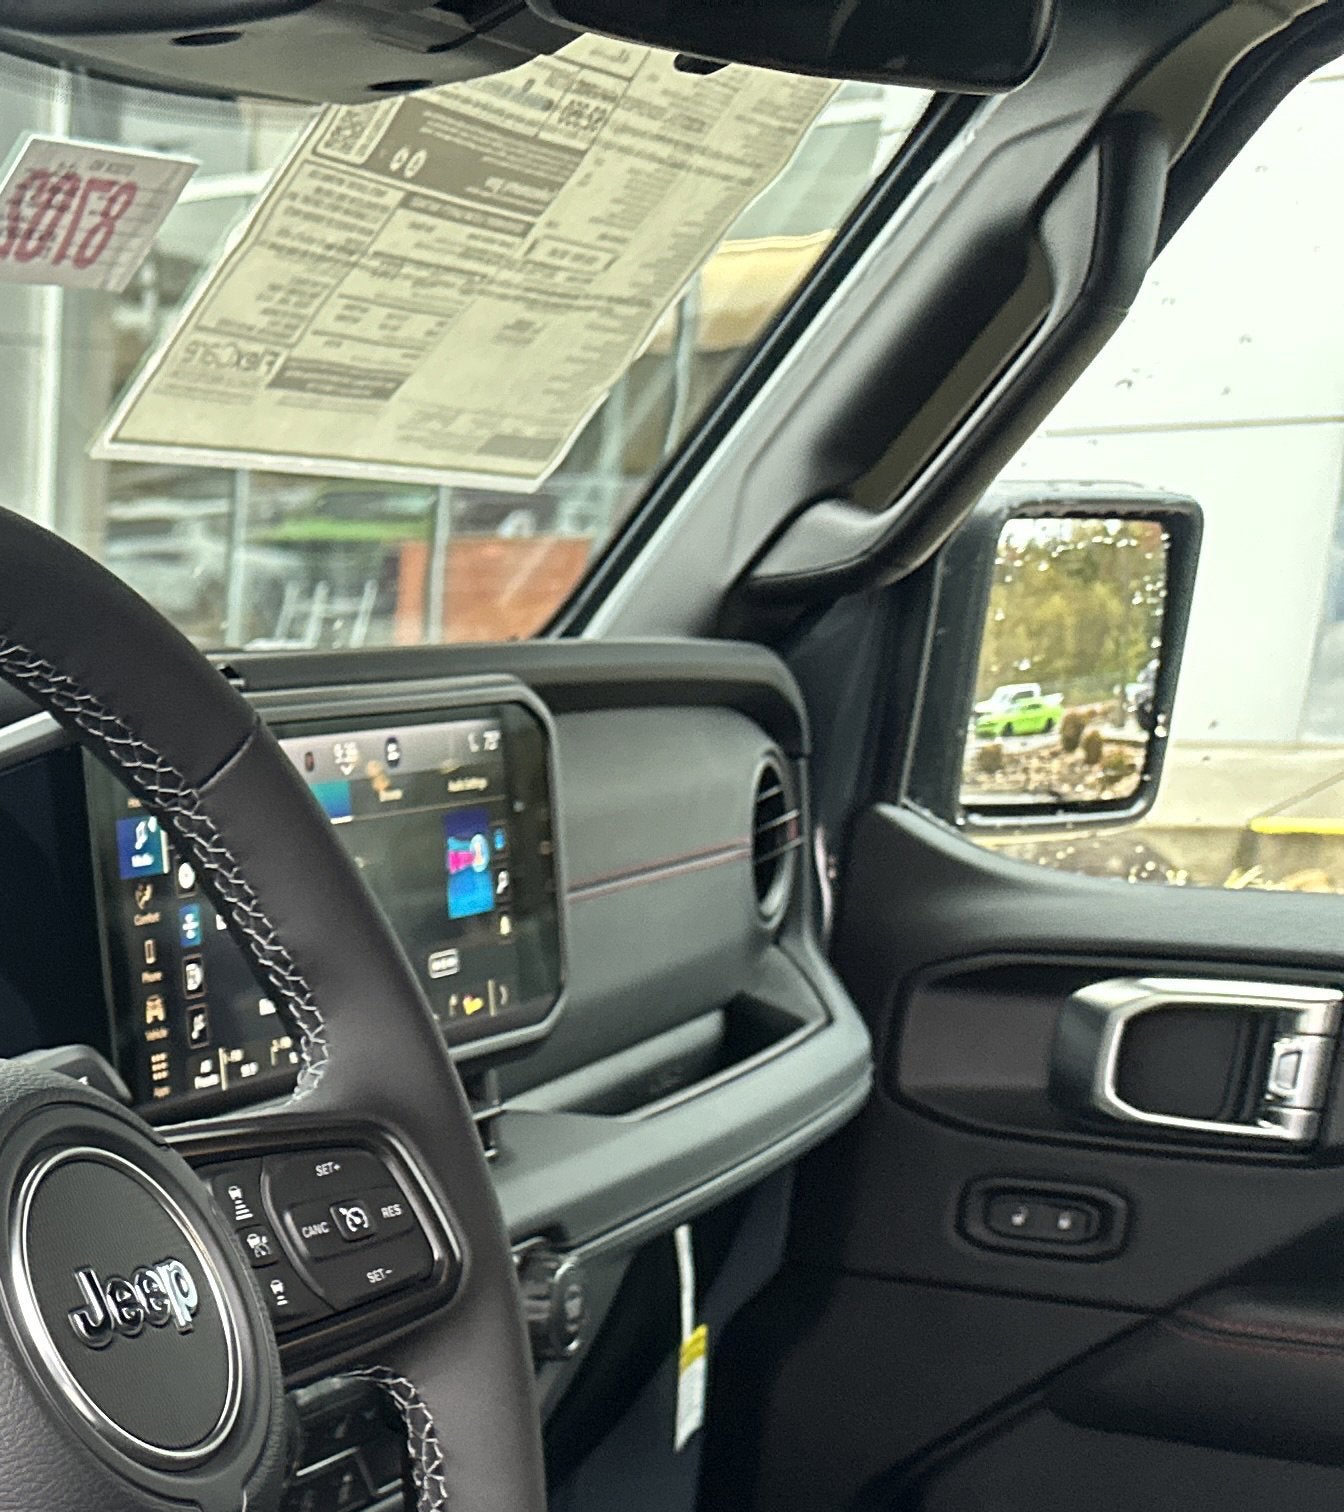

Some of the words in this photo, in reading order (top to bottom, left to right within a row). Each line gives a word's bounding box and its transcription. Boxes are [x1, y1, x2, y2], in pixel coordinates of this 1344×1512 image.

[315, 1161, 341, 1177] SET+
[380, 1203, 403, 1219] RES
[301, 1221, 331, 1239] CANC
[67, 1257, 199, 1348] Jeep
